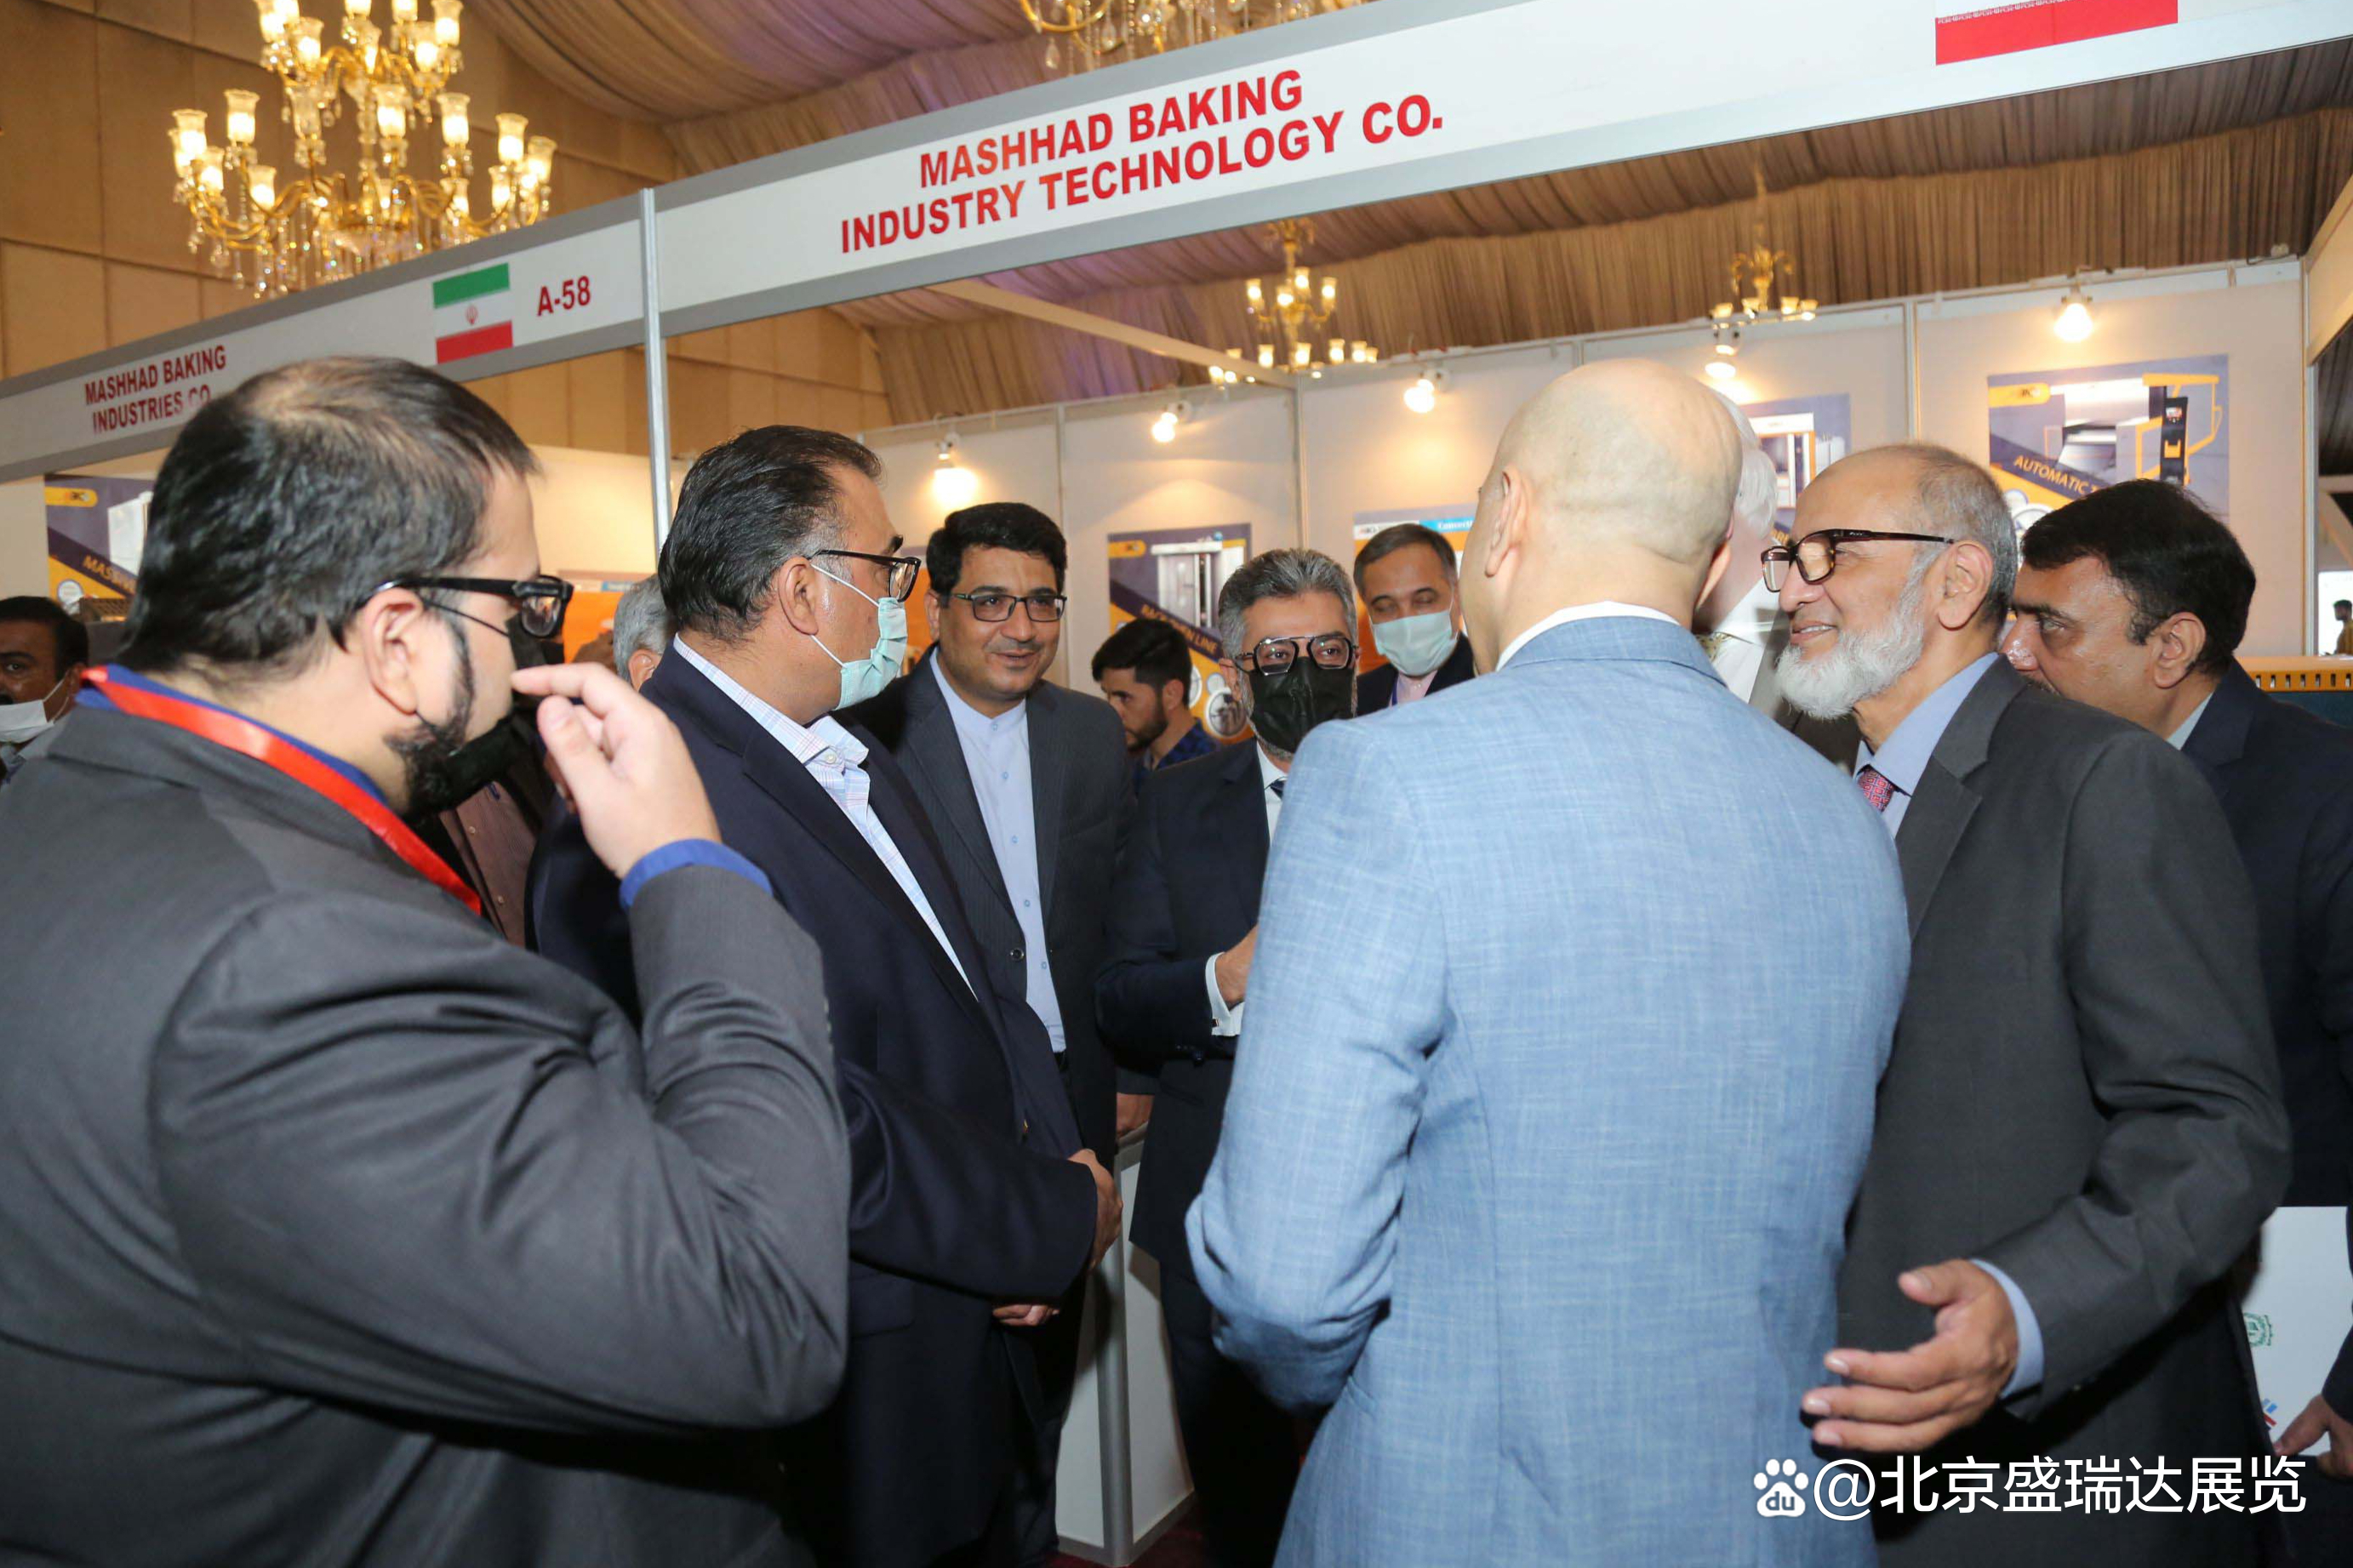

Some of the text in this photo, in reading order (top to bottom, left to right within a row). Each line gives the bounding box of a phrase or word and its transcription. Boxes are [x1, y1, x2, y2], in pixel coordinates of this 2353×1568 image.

[920, 69, 1303, 189] MASHHAD BAKING
[841, 94, 1444, 254] INDUSTRY TECHNOLOGY CO.
[536, 275, 591, 316] A-58
[84, 344, 227, 406] MASHHAD BAKING
[92, 390, 185, 435] INDUSTRIES
[2013, 454, 2089, 494] AUTOMATIC
